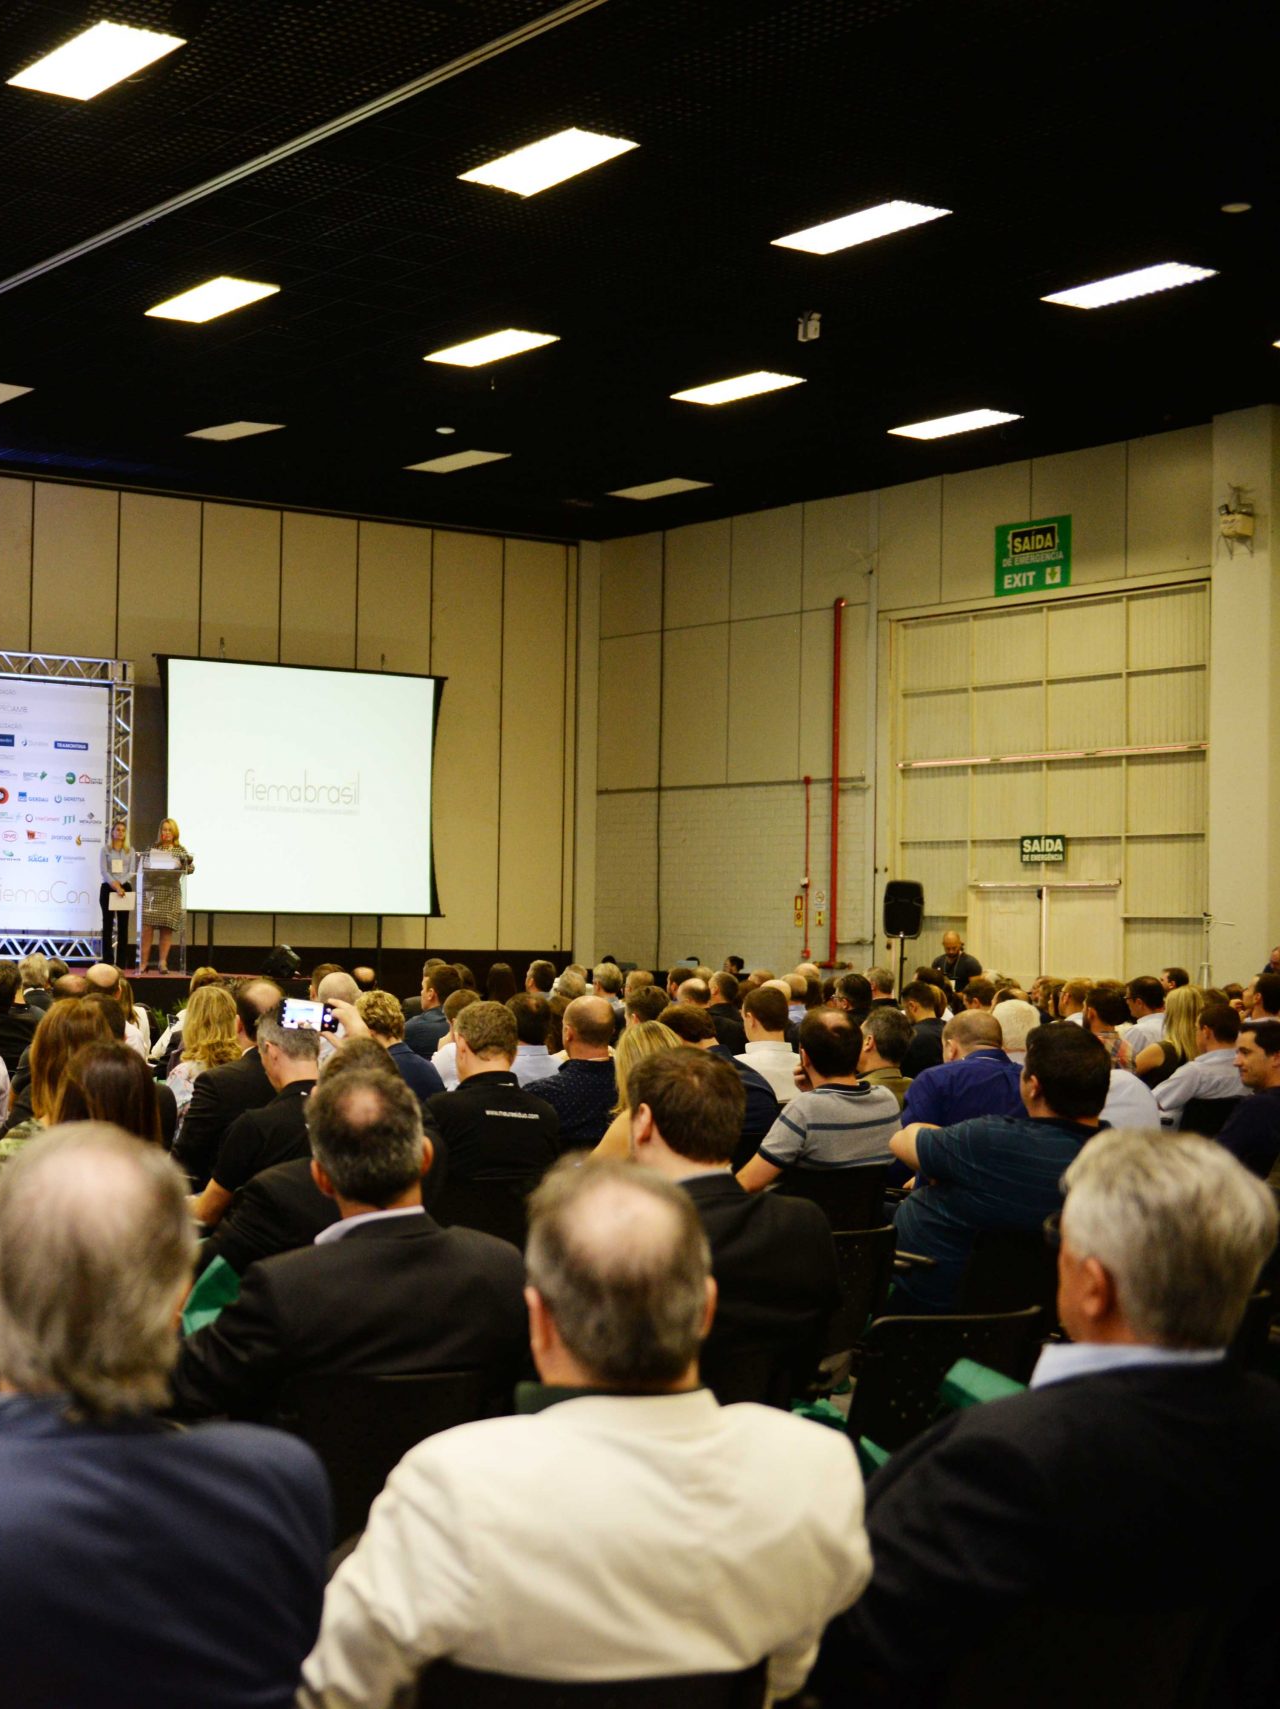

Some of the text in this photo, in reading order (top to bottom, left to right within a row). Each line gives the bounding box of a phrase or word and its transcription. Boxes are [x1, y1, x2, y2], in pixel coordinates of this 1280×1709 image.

[1013, 531, 1054, 553] SAÍDA
[1003, 571, 1036, 589] EXIT
[244, 767, 360, 805] fiemabrasil
[1022, 836, 1064, 853] SAÍDA
